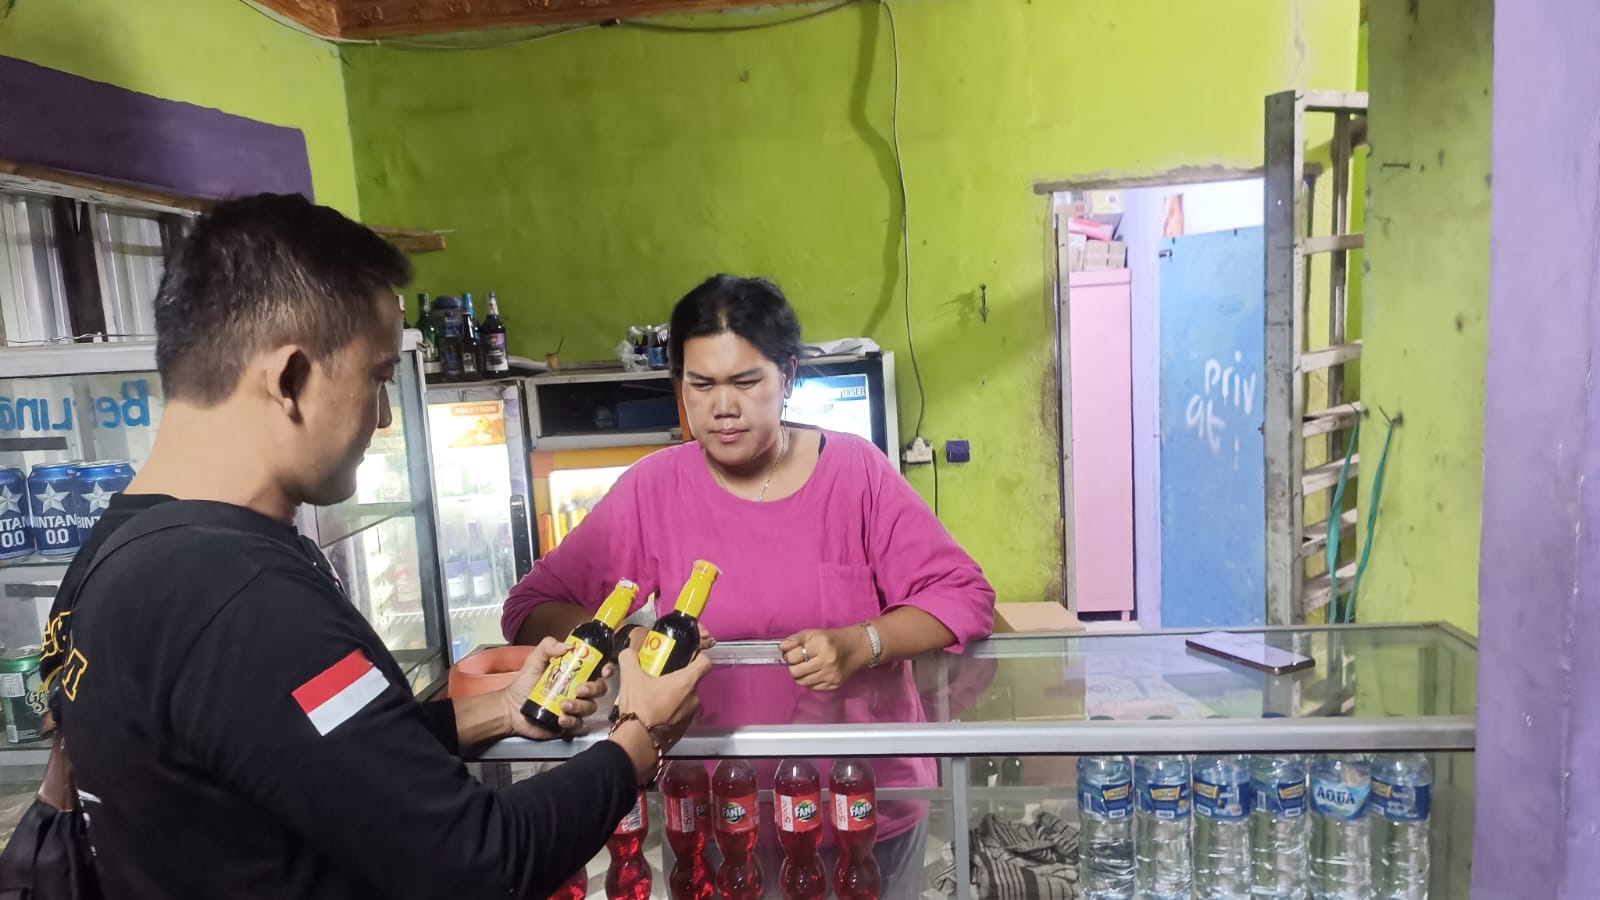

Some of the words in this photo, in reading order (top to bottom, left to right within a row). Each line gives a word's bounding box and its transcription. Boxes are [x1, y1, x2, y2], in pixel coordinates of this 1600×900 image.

[45, 528, 70, 545] 0.0
[1316, 786, 1356, 806] AQUA
[722, 806, 747, 818] FANTA
